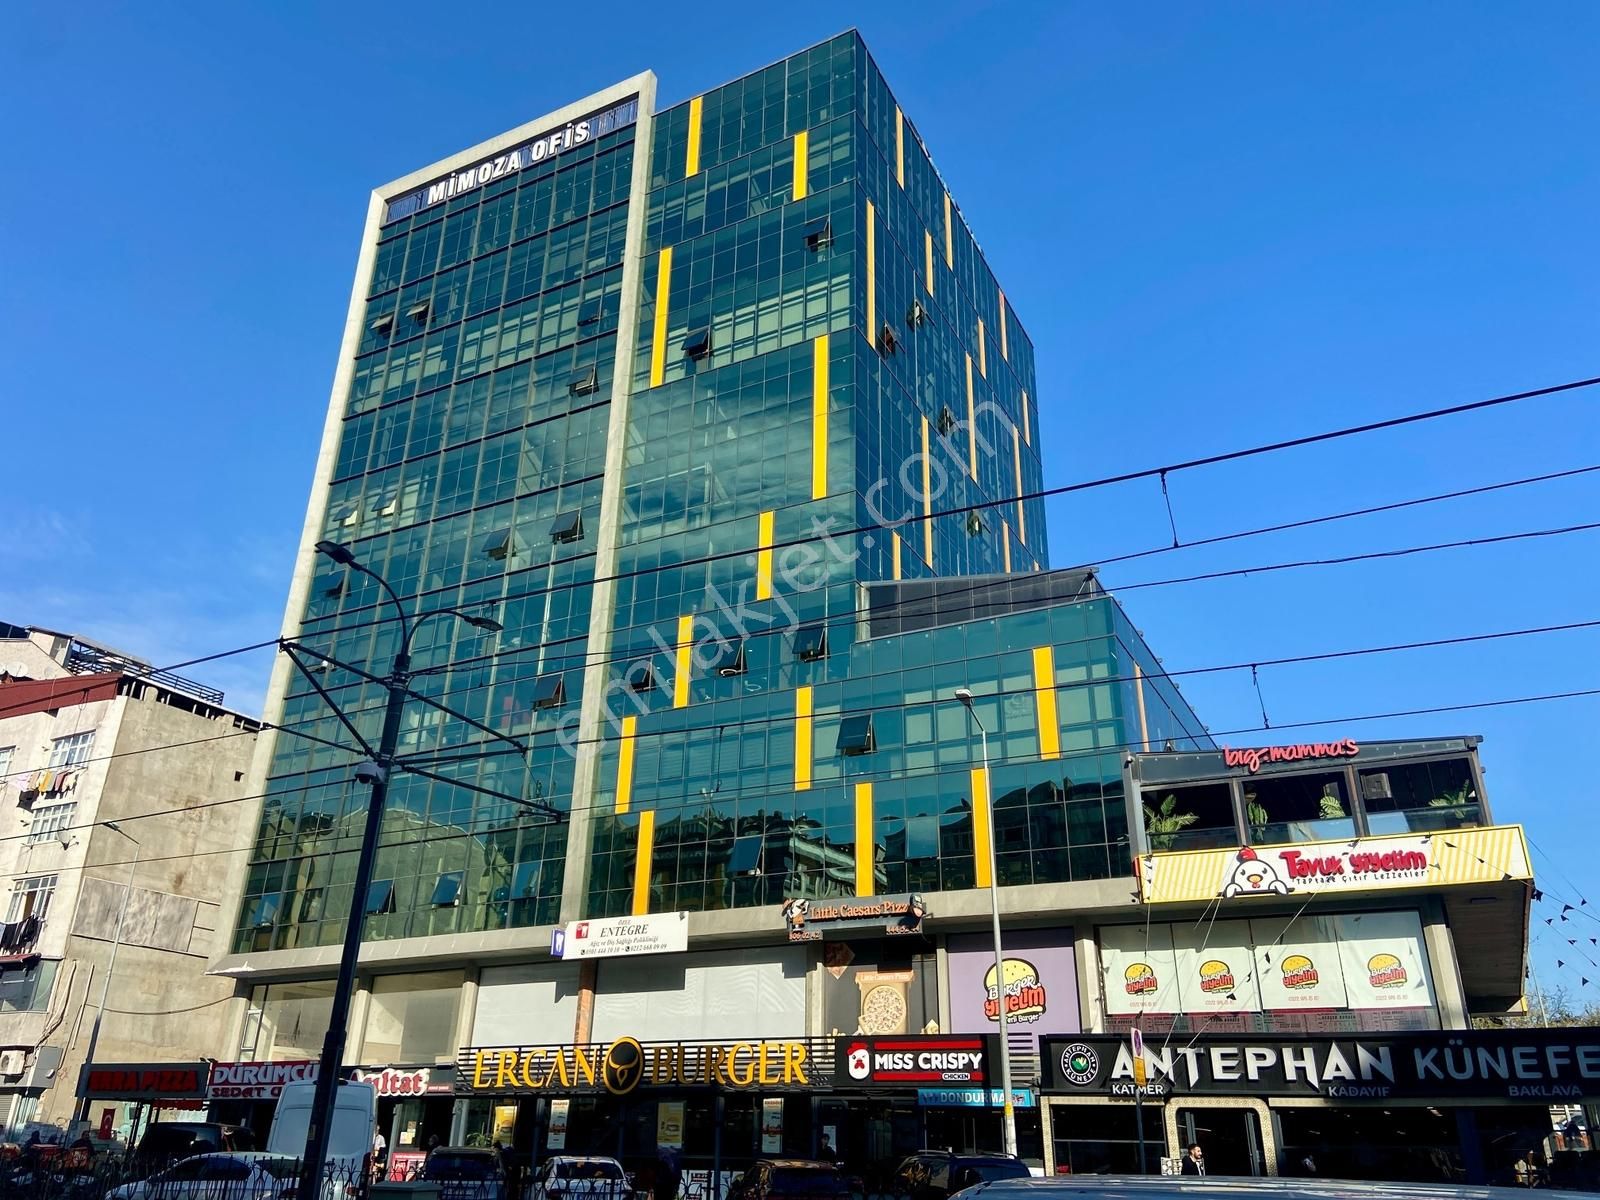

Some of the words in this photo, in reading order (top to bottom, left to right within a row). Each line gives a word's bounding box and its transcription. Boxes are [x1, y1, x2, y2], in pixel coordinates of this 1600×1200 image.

[1279, 850, 1344, 879] Tavuk
[810, 905, 839, 919] Little
[840, 903, 881, 916] Caesars
[884, 900, 910, 914] Pizz
[600, 923, 649, 938] ENTEGRE
[988, 975, 1038, 1000] Brger
[472, 1047, 598, 1089] ERCAN
[651, 1042, 810, 1087] BURGER
[875, 1053, 914, 1070] MISS
[918, 1052, 982, 1070] CRISPY
[1111, 1040, 1395, 1092] ANTEPHAN
[1414, 1038, 1600, 1080] KÜNEFE
[211, 1087, 267, 1098] SEDAT
[940, 1092, 1005, 1103] DONDURMA
[1112, 1084, 1164, 1095] KATMER
[1328, 1085, 1390, 1098] KADAYIF
[1509, 1084, 1582, 1097] BAKLAVA
